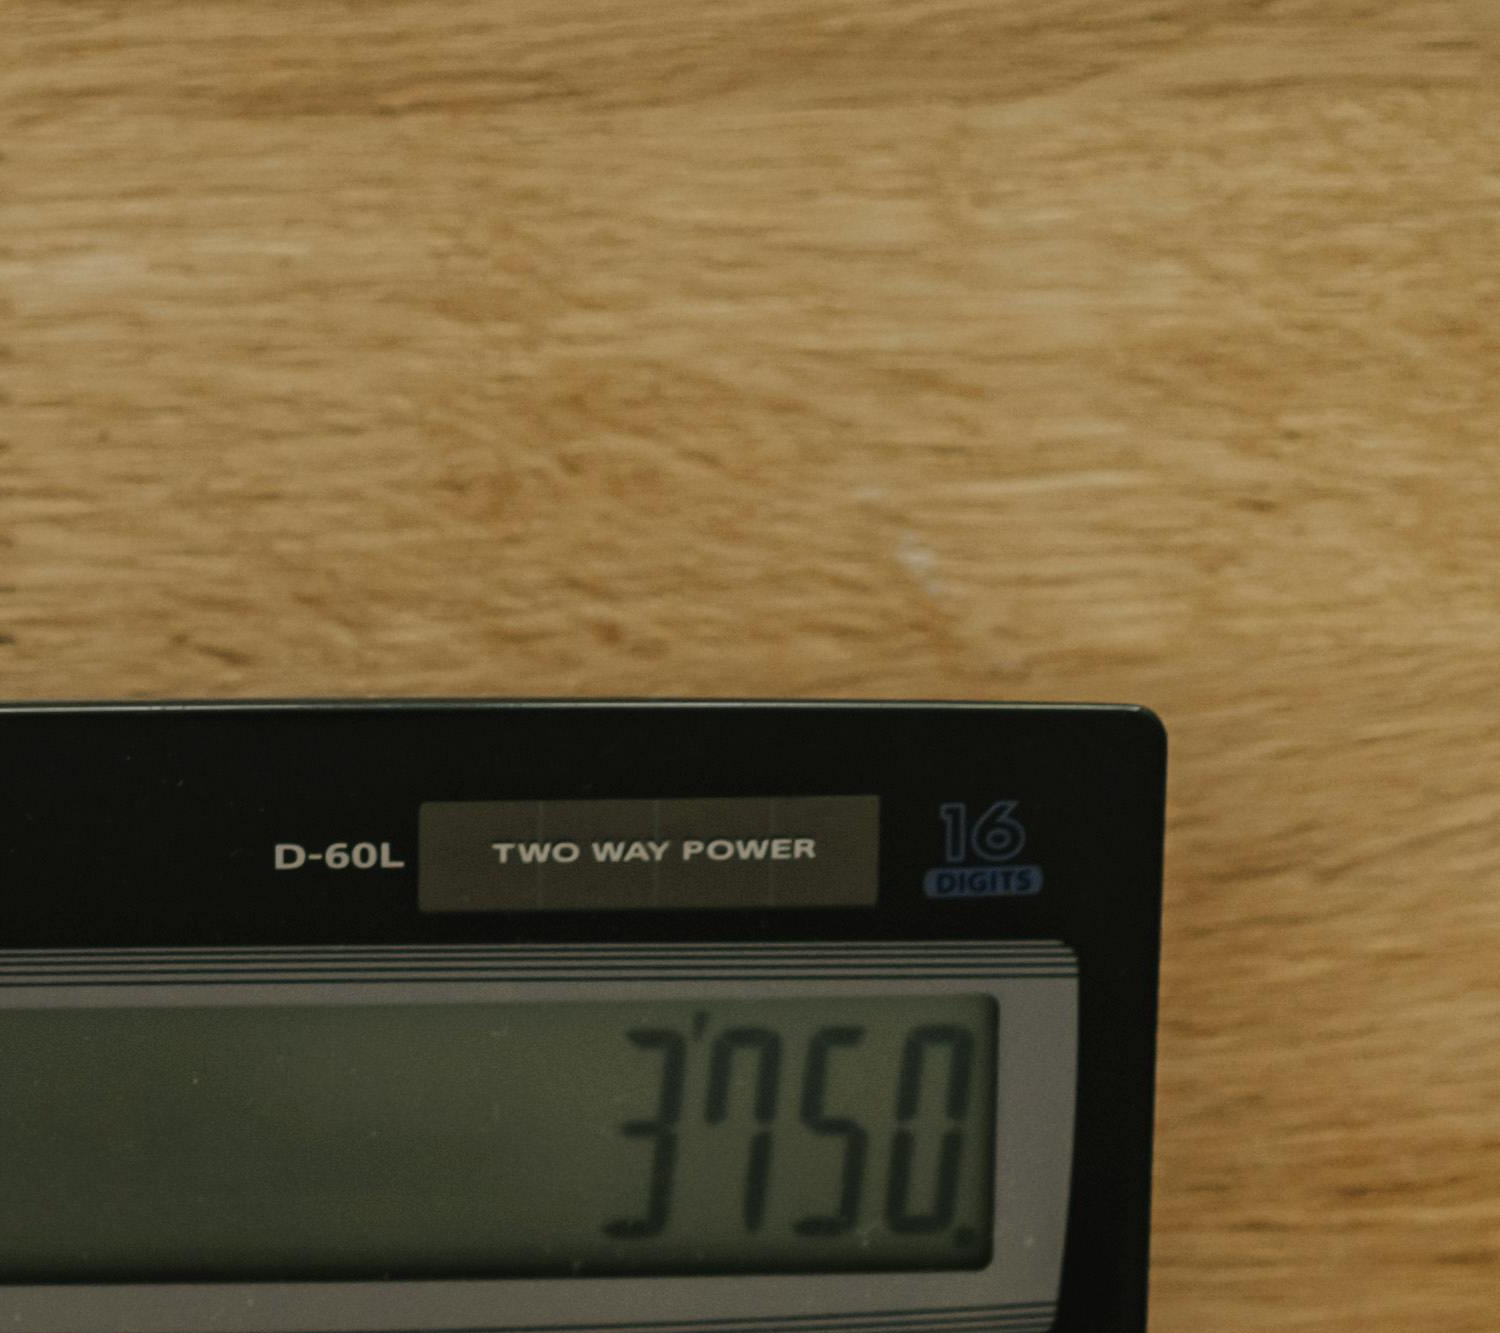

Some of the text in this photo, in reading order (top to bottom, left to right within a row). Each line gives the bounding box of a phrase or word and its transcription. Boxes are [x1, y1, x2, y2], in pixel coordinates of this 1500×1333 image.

[939, 799, 1027, 863] 16
[274, 841, 405, 870] D-60L
[492, 838, 816, 864] TWO WAY POWER
[934, 868, 1032, 894] DIGITS
